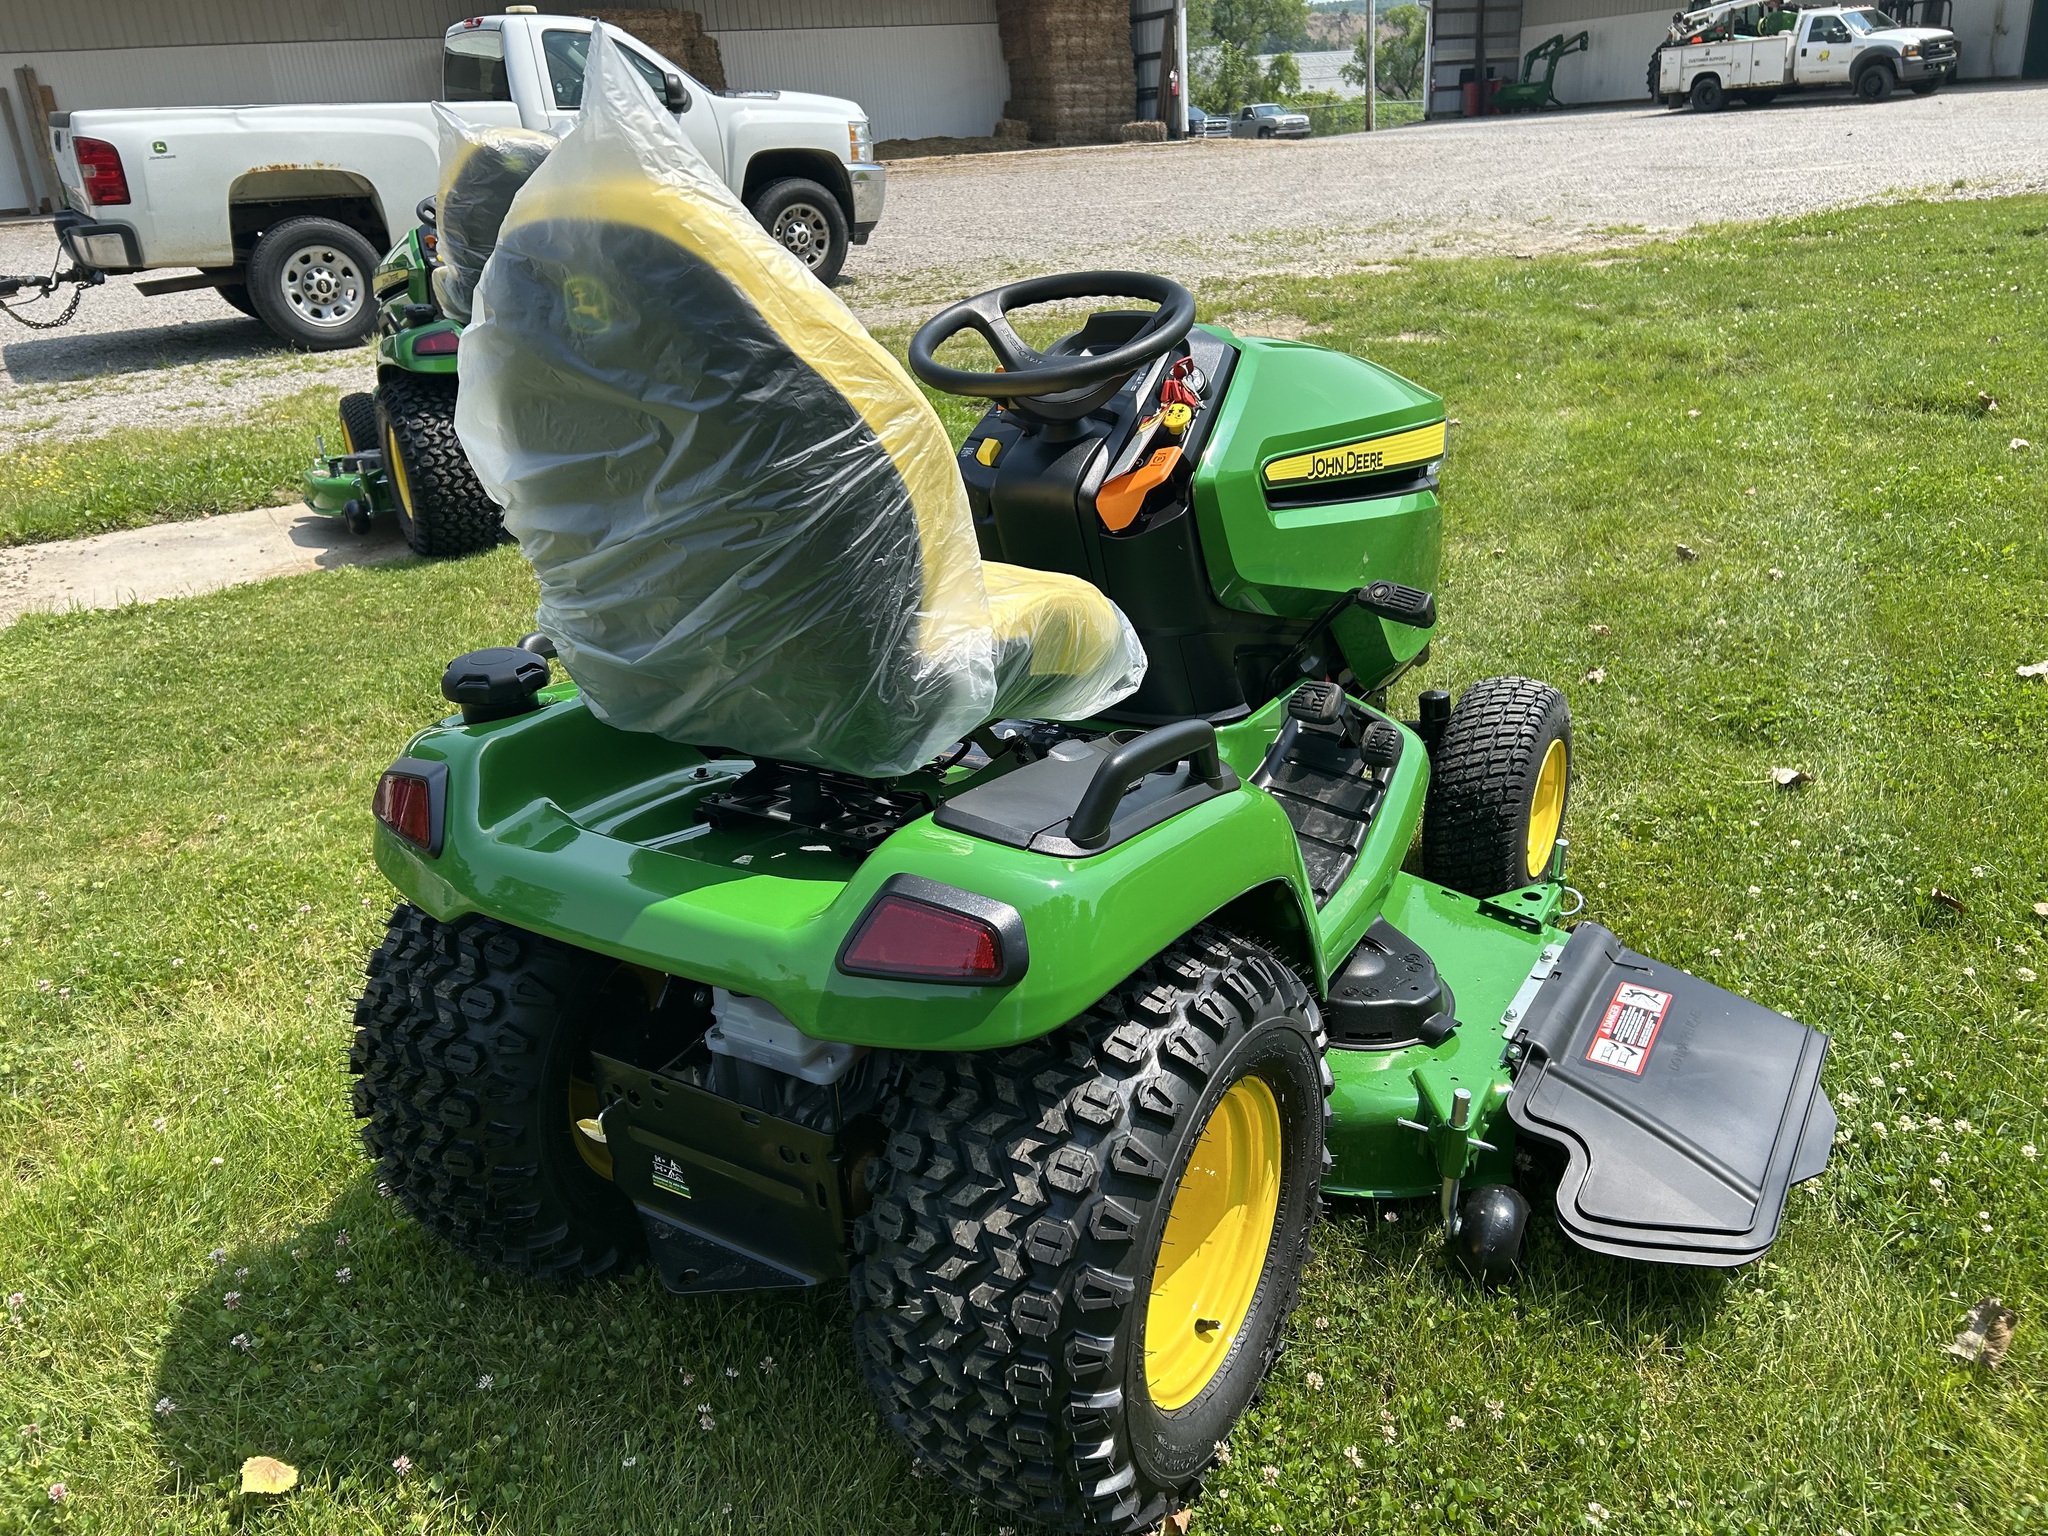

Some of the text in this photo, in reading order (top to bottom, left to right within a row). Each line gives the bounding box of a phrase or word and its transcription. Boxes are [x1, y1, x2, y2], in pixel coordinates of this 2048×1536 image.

[1307, 451, 1384, 477] JOHN DEERE
[1602, 1004, 1622, 1029] DANGER
